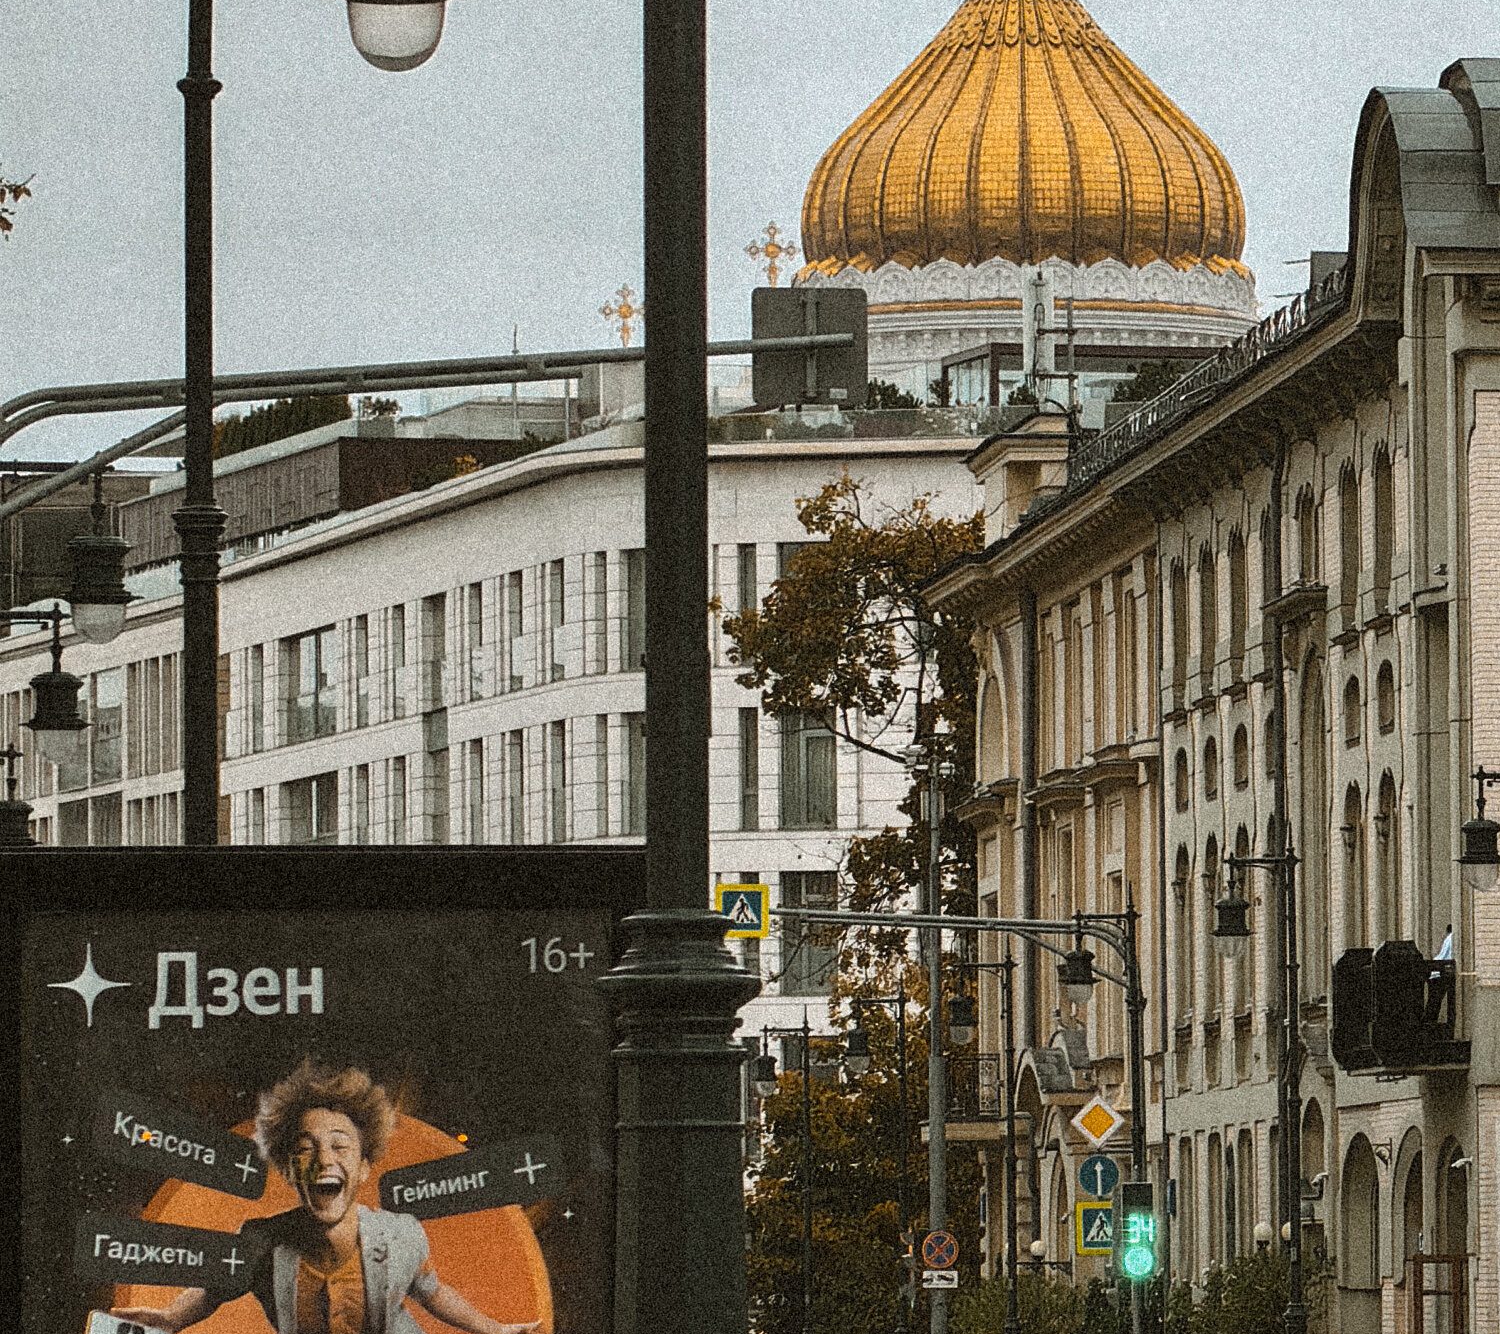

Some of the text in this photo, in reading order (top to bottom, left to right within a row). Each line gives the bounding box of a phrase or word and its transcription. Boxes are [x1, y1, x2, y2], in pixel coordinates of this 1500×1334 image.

[520, 936, 596, 974] 16+
[148, 951, 326, 1029] Дзен
[112, 1110, 217, 1166] Красота
[391, 1169, 490, 1206] Гейминг
[1127, 1215, 1154, 1244] 34
[93, 1233, 204, 1267] Гаджеты
